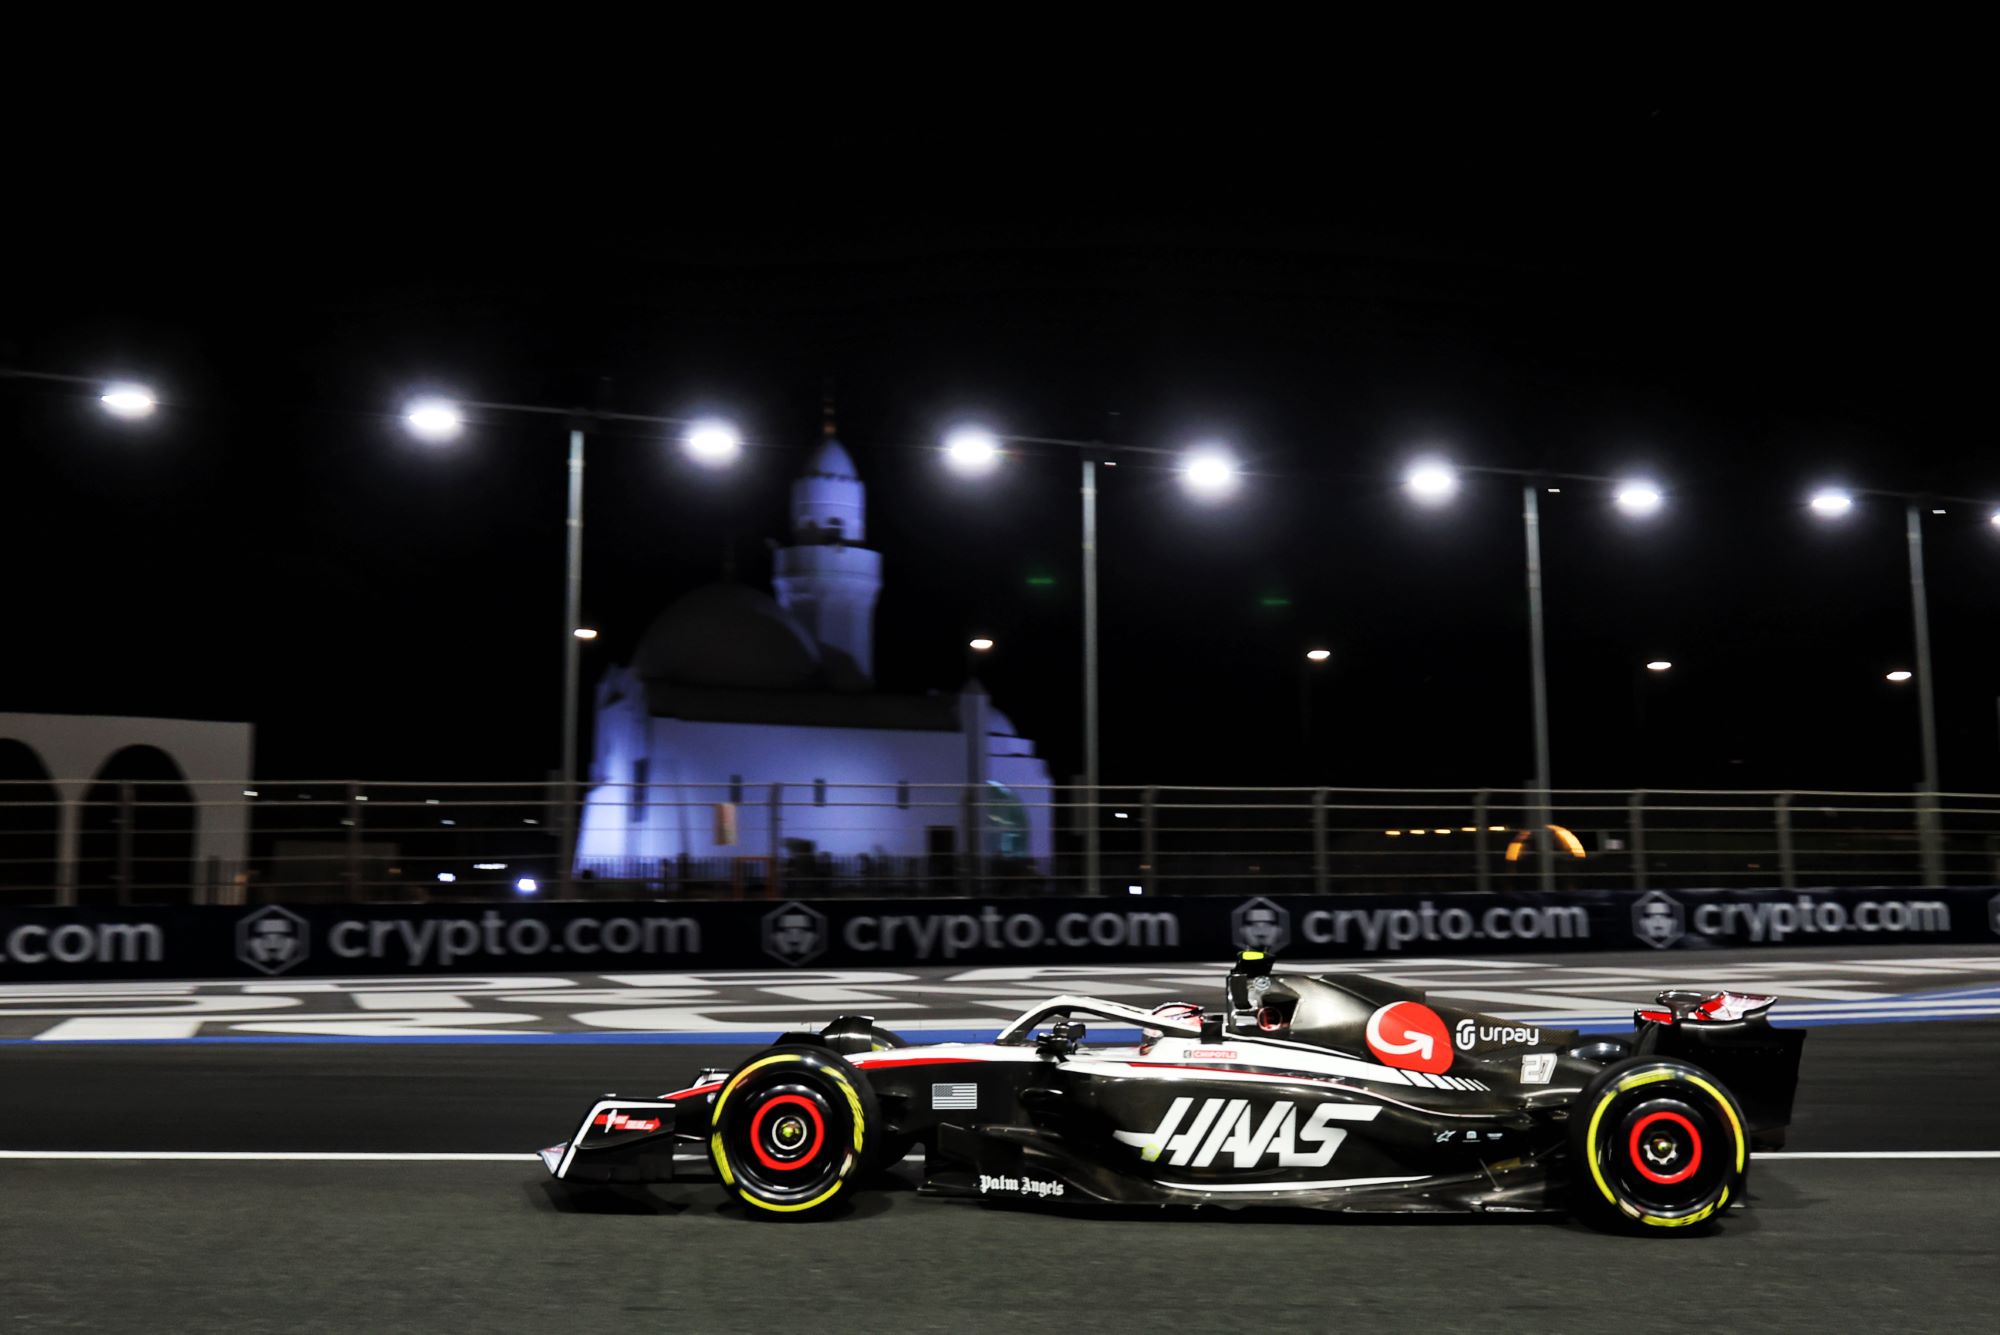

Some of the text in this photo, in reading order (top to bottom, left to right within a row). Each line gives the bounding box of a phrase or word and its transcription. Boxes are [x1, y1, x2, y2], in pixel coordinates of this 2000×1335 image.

[329, 910, 701, 966] crypto.com
[844, 906, 1180, 958] crypto.com
[1303, 900, 1590, 951] crypto.com
[1694, 895, 1950, 942] crypto.com
[1480, 1026, 1539, 1046] urpay
[1520, 1053, 1557, 1084] 27
[1113, 1097, 1383, 1168] HAAS
[980, 1175, 1064, 1198] Palm Angels
